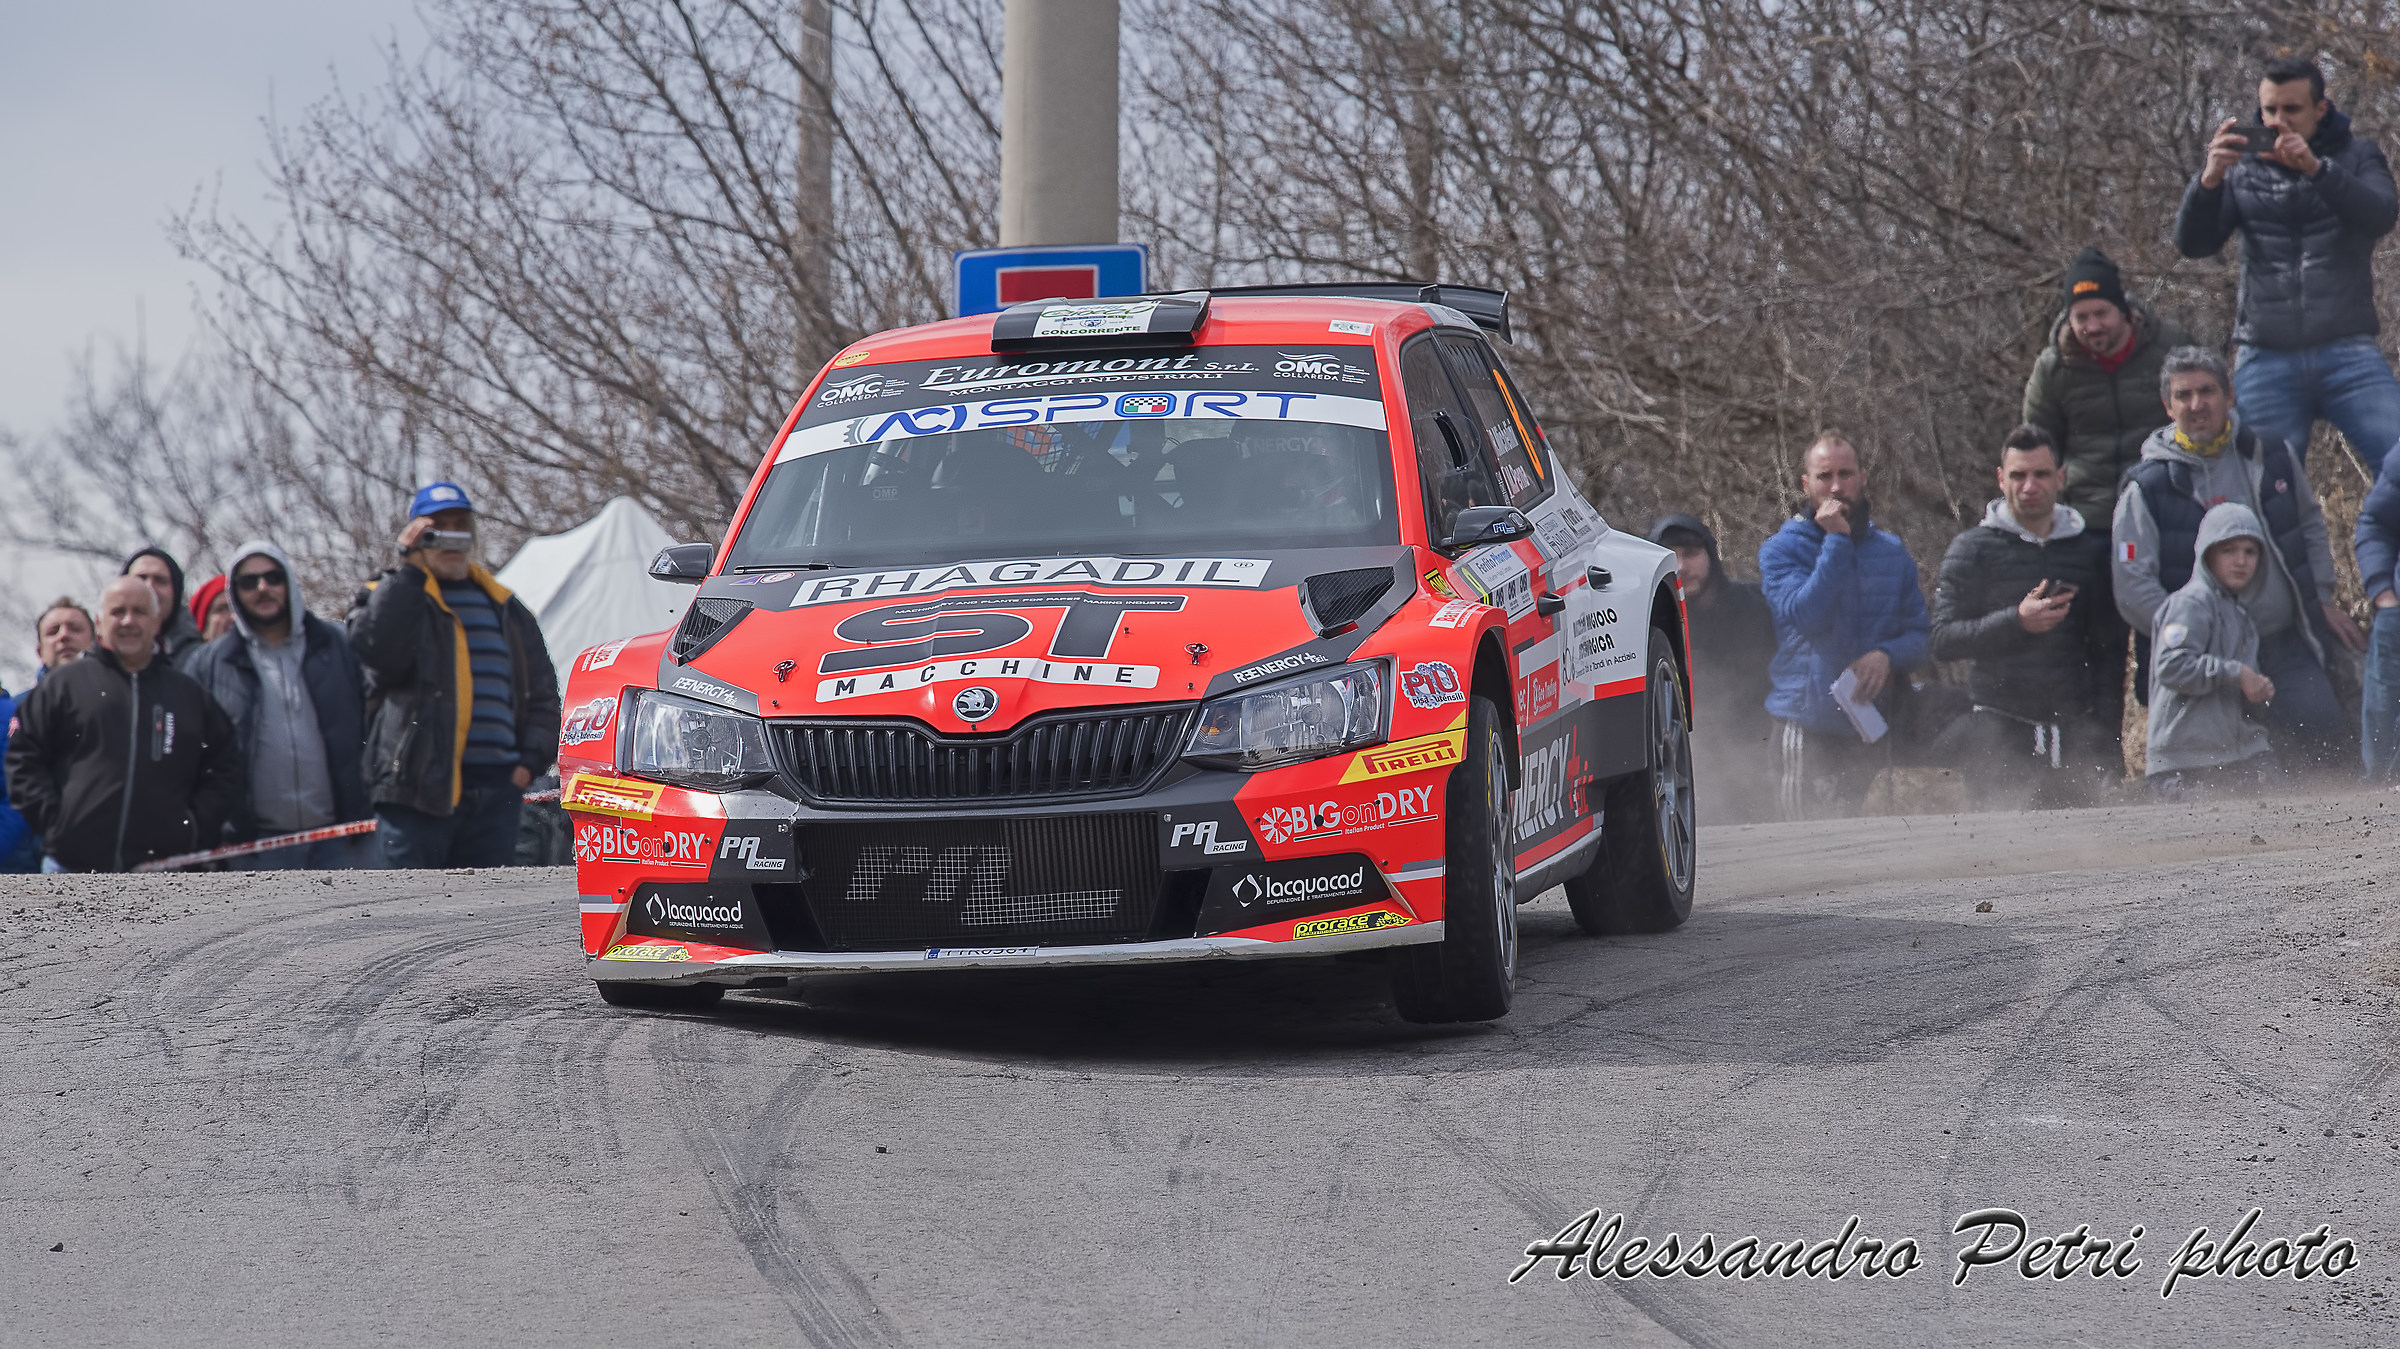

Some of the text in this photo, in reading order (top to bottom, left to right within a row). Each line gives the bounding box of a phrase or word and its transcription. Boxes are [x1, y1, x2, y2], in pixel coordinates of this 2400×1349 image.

[1041, 325, 1140, 336] CONCORRENTE
[919, 354, 1198, 388] Euromont
[1275, 360, 1341, 375] OMC
[1273, 371, 1338, 381] COLLAREDA
[820, 381, 883, 402] OMC
[948, 372, 1224, 397] MONTAGGI INDUSTRIALI
[816, 392, 878, 408] COLLAREDA
[978, 392, 1318, 428] SPORT
[872, 488, 898, 499] OMP
[894, 602, 954, 615] MACHINERY
[817, 592, 1188, 674] ST
[1605, 658, 1612, 667] in
[1614, 652, 1637, 664] Acciaio
[834, 661, 1135, 697] MACCHINE
[1361, 739, 1457, 775] PIRELLI
[1363, 822, 1385, 832] Product
[1212, 842, 1245, 852] RACING
[753, 860, 784, 868] RACING
[1266, 867, 1364, 901] lacquacad
[1266, 897, 1301, 905] DEPURAZIONE
[1311, 891, 1346, 900] TRATTAMENTO
[667, 898, 742, 928] lacquacad
[1296, 915, 1370, 938] prorace
